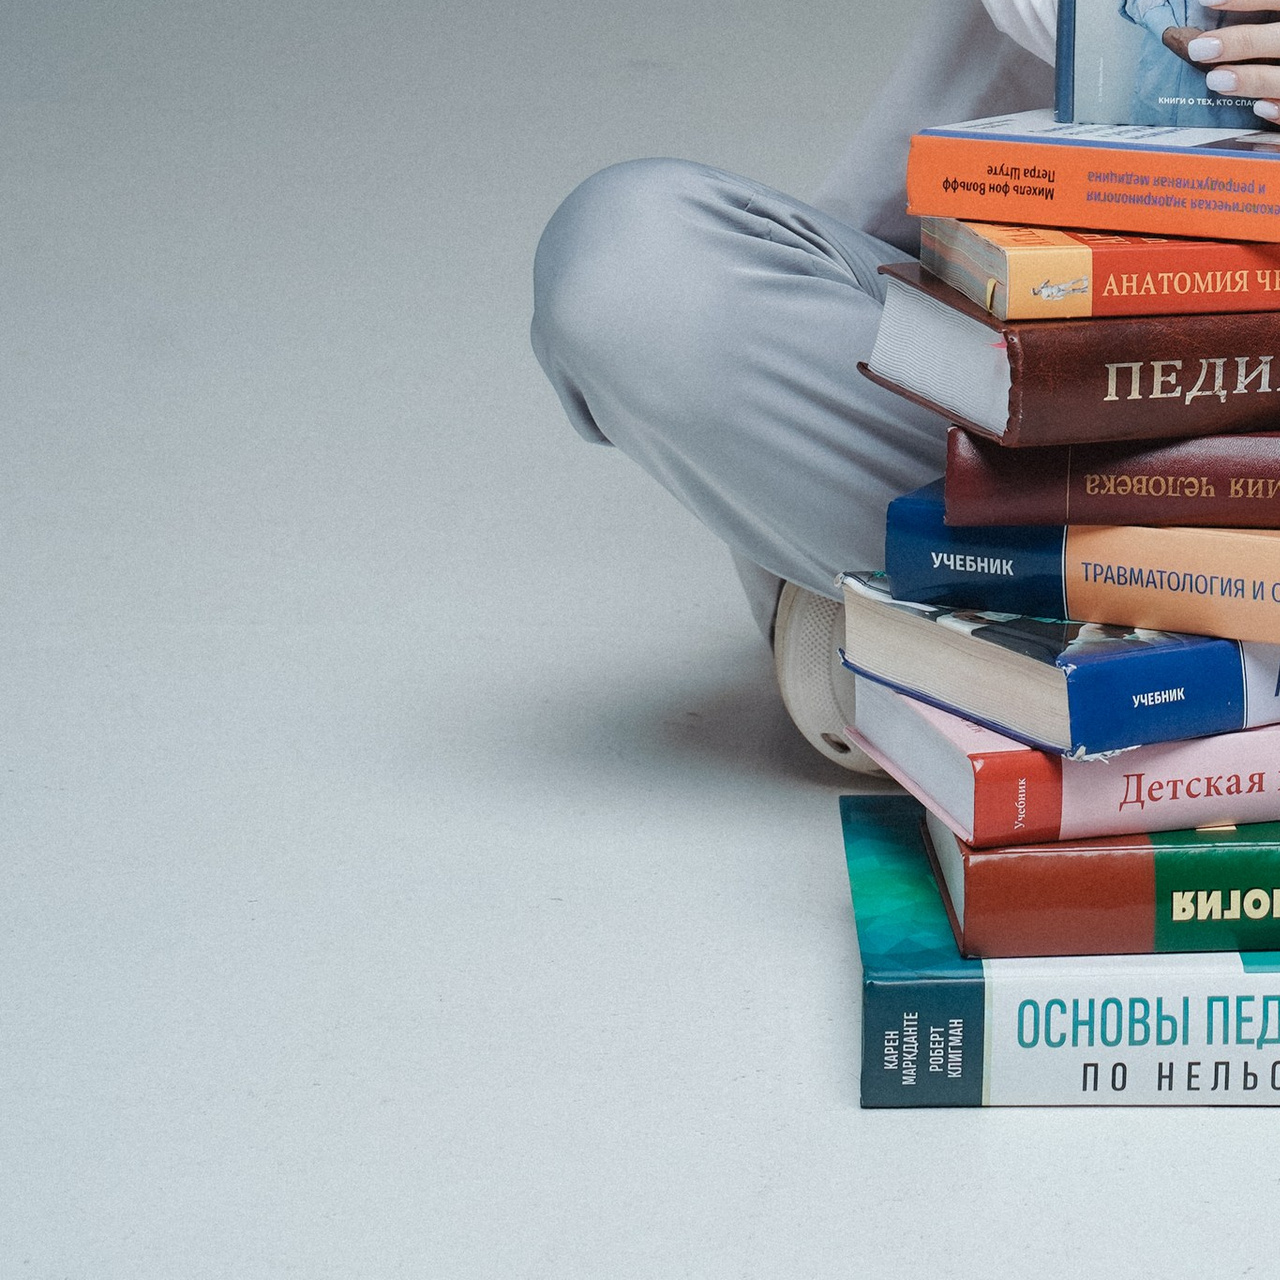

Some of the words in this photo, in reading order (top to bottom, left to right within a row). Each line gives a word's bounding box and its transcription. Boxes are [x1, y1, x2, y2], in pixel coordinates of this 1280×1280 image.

[1158, 97, 1186, 105] КНИГИ
[1196, 98, 1215, 106] ТЕХ,
[987, 163, 1021, 181] Штуте
[1023, 168, 1056, 183] Петра
[1087, 170, 1150, 186] медицина
[1152, 174, 1255, 195] репродуктивная
[942, 176, 986, 195] Вольфф
[988, 180, 1010, 195] фон
[1013, 184, 1055, 200] Михель
[1257, 183, 1266, 194] и
[1086, 190, 1187, 210] эндокринология
[1102, 269, 1249, 297] АНАТОМИЯ
[1083, 473, 1216, 498] человека
[930, 551, 1015, 576] УЧЕБНИК
[1080, 561, 1245, 599] ТРАВМАТОЛОГИЯ
[1252, 581, 1265, 601] И
[1132, 687, 1186, 708] УЧЕБНИК
[1014, 778, 1026, 830] Учебник
[1118, 771, 1266, 812] Детская
[1017, 995, 1190, 1049] ОСНОВЫ
[883, 1030, 900, 1070] КАРЕН
[902, 1011, 919, 1085] МАРКДАНТЕ
[929, 1026, 945, 1072] РОБЕРТ
[947, 1019, 964, 1078] КЛИГМАН
[1081, 1061, 1128, 1092] ПО
